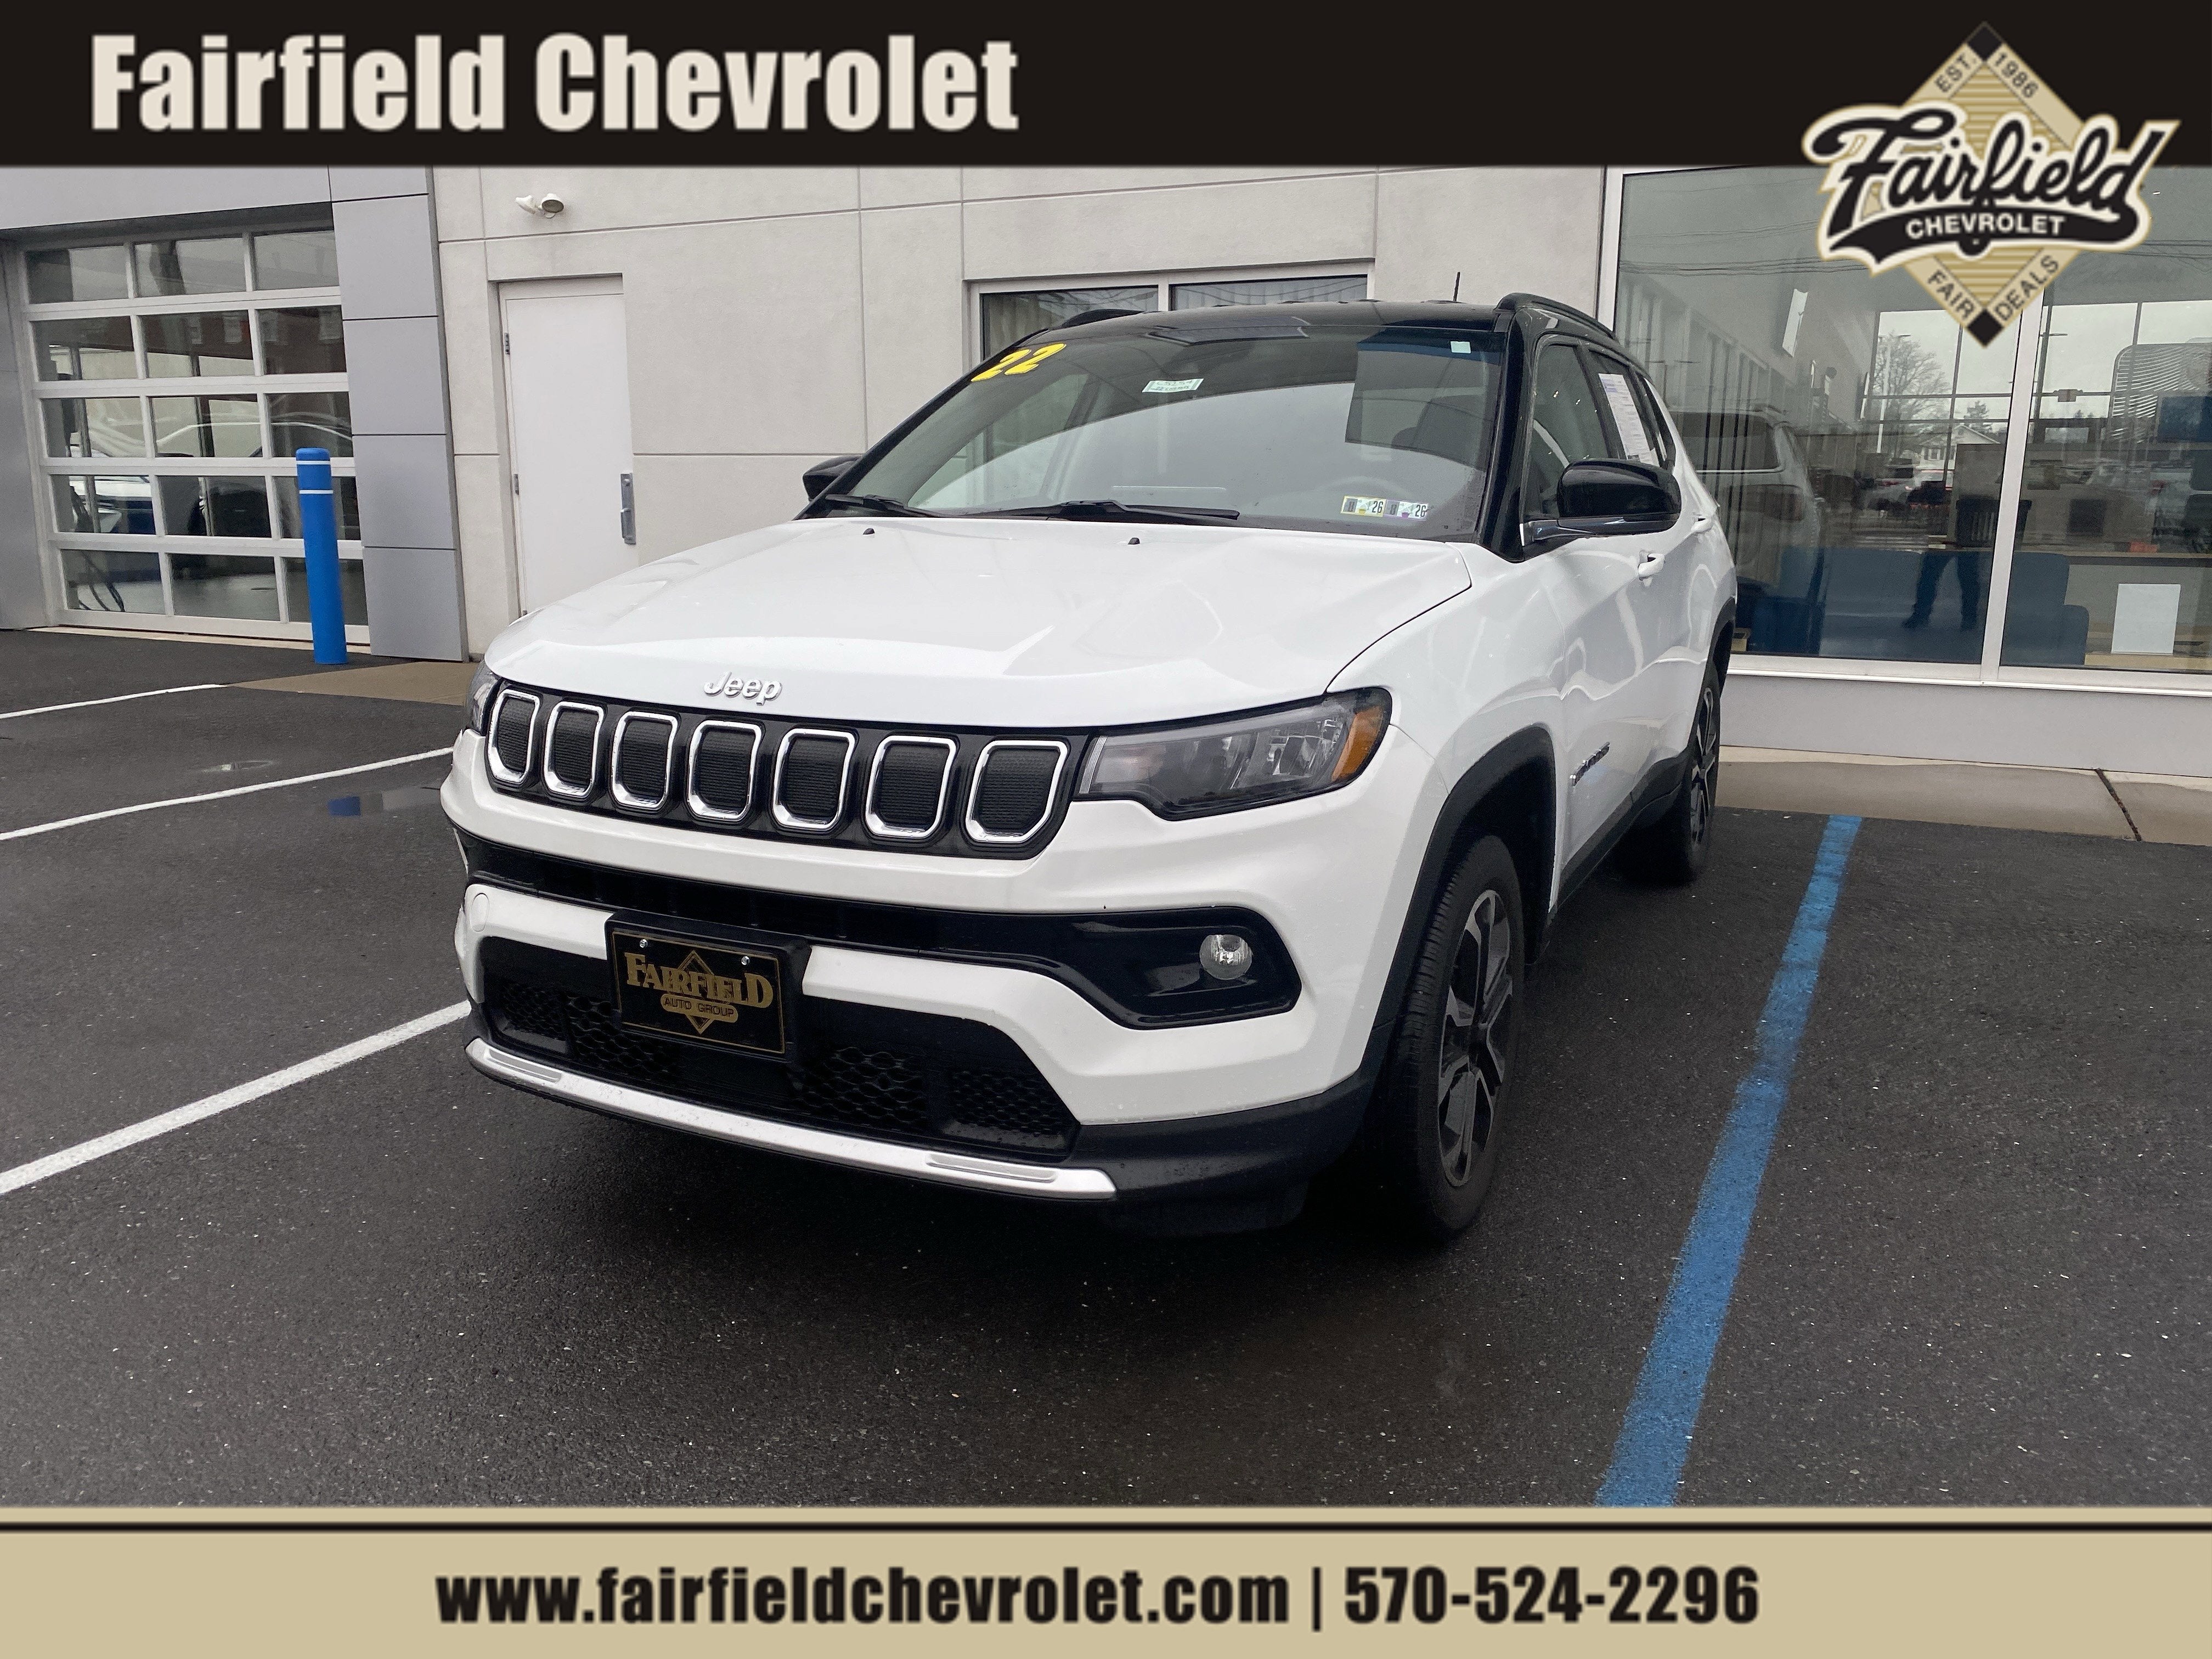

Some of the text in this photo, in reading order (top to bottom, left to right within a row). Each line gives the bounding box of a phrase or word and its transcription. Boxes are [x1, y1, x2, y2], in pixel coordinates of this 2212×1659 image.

[970, 342, 1067, 382] 22
[1372, 500, 1384, 514] 26
[1414, 504, 1426, 517] 26
[703, 671, 783, 706] Jeep
[624, 952, 774, 1008] FAIRFIELD
[664, 997, 735, 1018] AUTO GROUP
